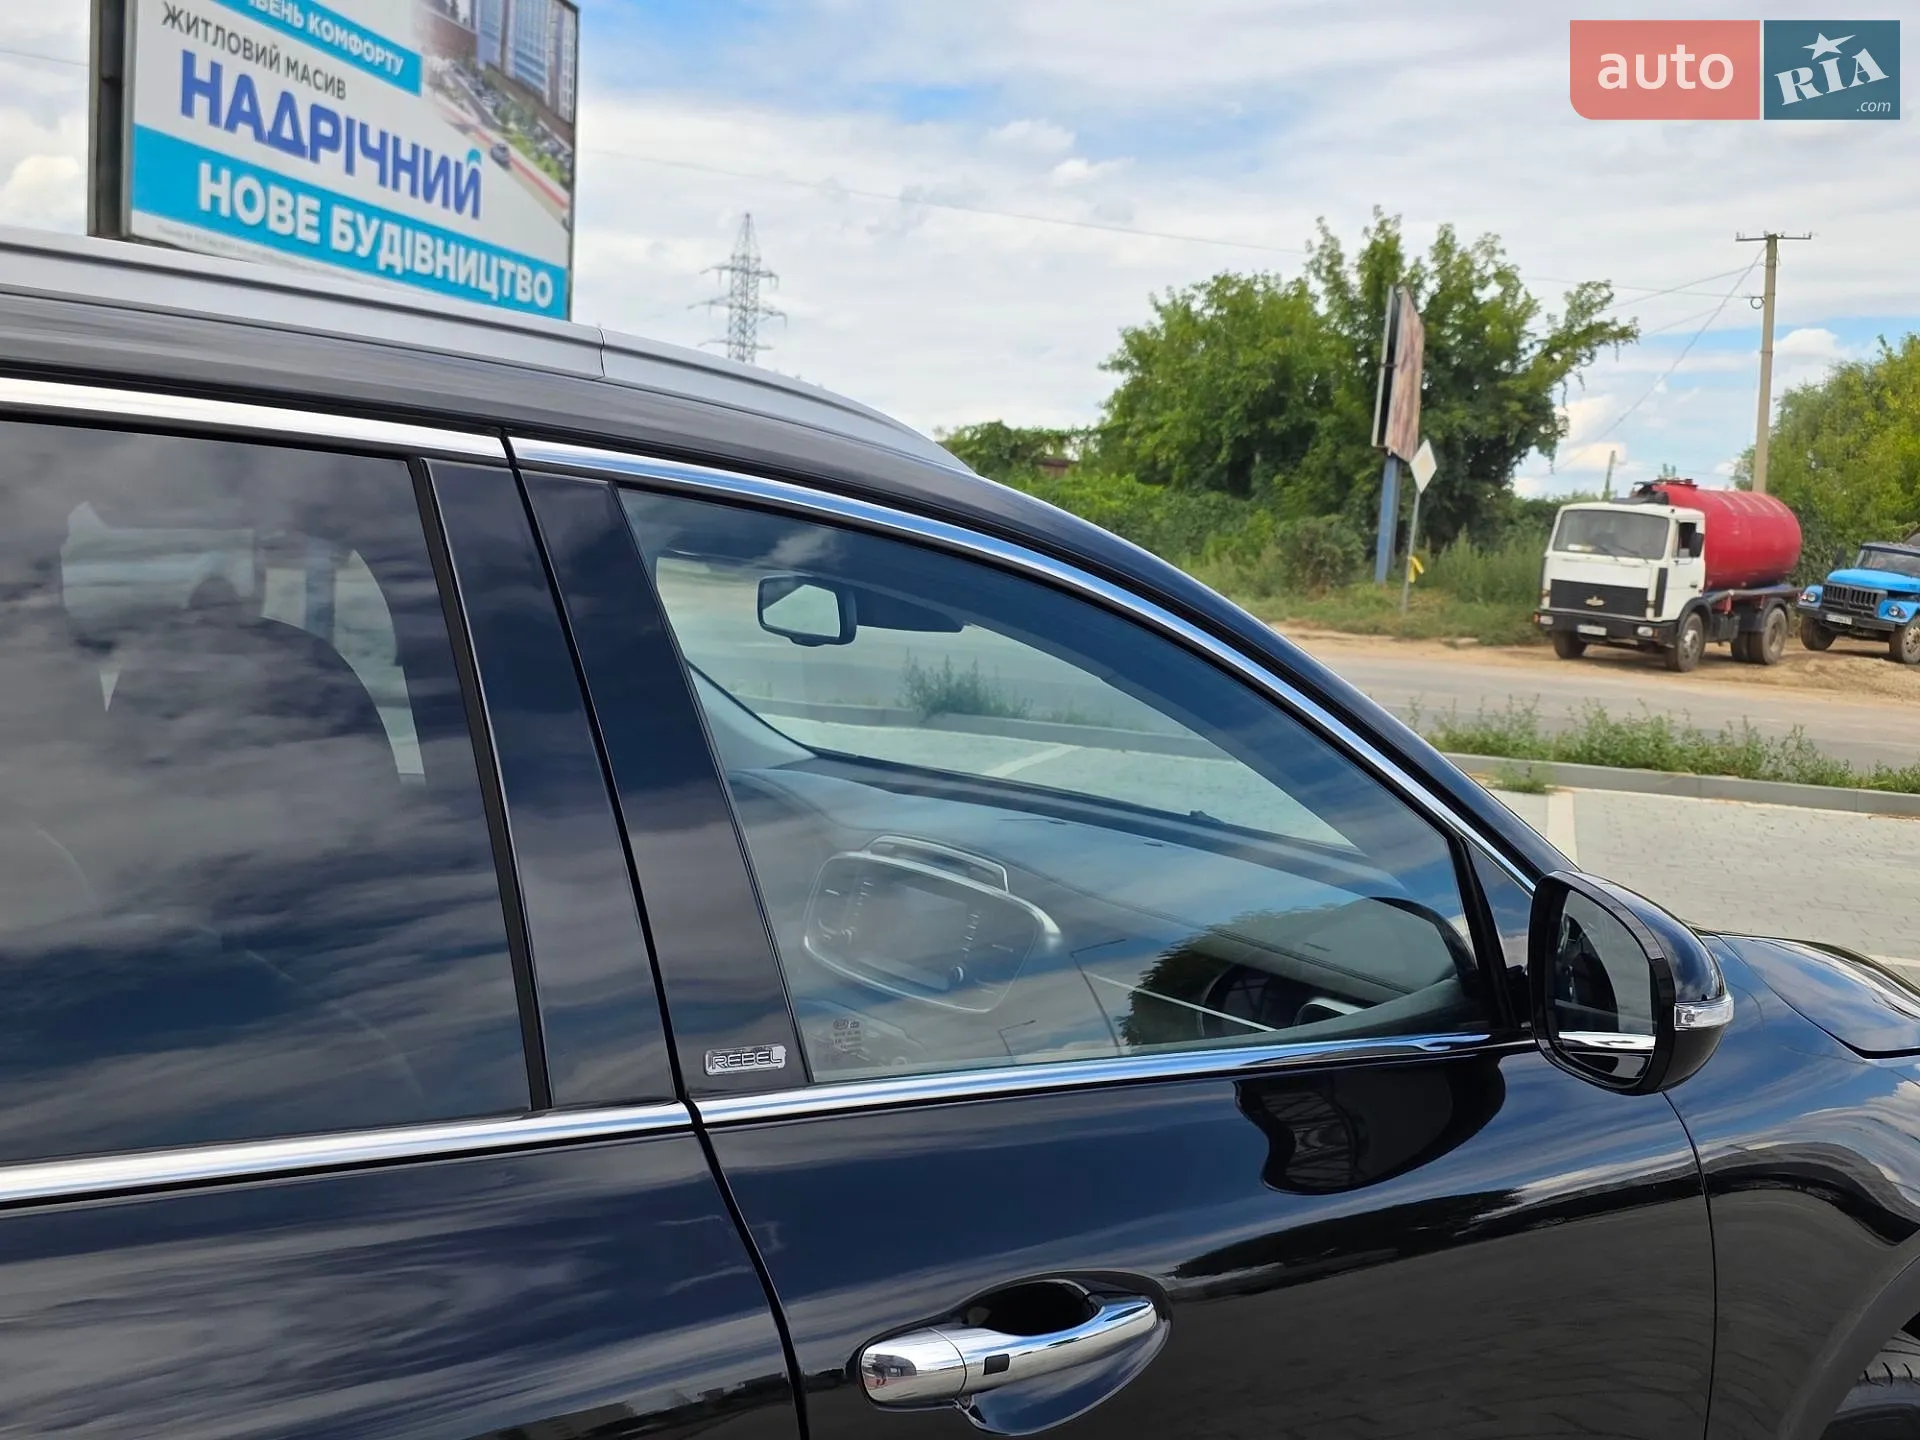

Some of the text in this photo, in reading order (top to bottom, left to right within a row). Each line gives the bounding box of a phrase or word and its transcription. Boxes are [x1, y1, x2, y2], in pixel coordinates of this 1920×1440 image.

[161, 0, 347, 101] ЖИТЛОВИЙ МАСИВ
[249, 0, 404, 76] ВЕНЬ КОМФОРТУ
[181, 49, 481, 220] НАДРІЧНИЙ
[199, 161, 322, 245] НОВЕ
[330, 206, 553, 308] БУДІВНИЦТВО
[711, 1050, 782, 1069] REBEL
